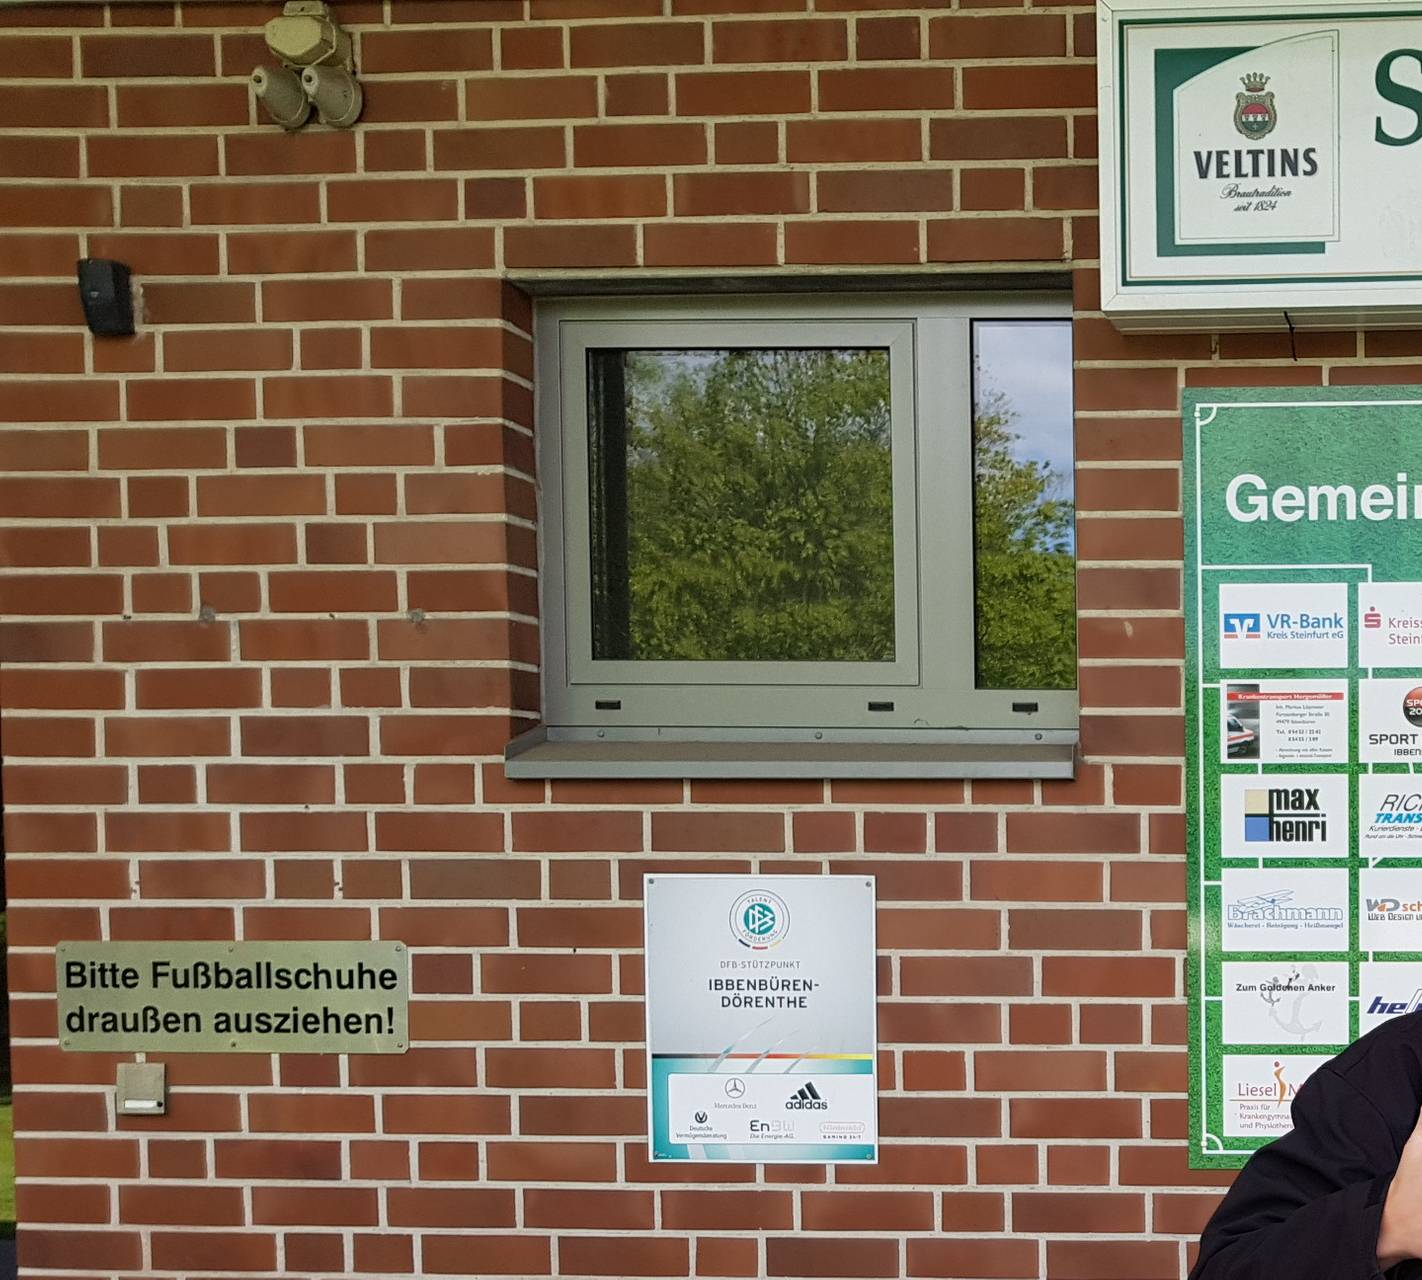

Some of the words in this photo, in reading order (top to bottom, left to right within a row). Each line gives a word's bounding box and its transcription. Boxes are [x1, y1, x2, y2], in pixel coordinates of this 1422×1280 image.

[1193, 147, 1318, 179] VELTINS
[1220, 183, 1292, 199] Brautradition
[1233, 202, 1251, 212] seit
[1253, 200, 1278, 212] 1824
[1266, 613, 1344, 629] VR-Bank
[1267, 631, 1288, 639] Kreis
[1290, 630, 1328, 640] Steinfurt
[1330, 631, 1344, 640] eG
[1369, 733, 1418, 745] SPORT
[1269, 788, 1319, 810] max
[1269, 814, 1327, 842] henri
[1228, 904, 1344, 920] Brachmann
[65, 961, 140, 989] Bitte
[152, 961, 398, 990] Fußballschuhe
[708, 976, 820, 992] IBBENBÜREN-
[1236, 983, 1257, 992] Zum
[1259, 983, 1304, 992] Goldenen
[1308, 983, 1336, 992] Anker
[721, 993, 808, 1008] DÖRENTHE
[66, 1005, 202, 1034] draußen
[214, 1006, 395, 1035] ausziehen!
[1238, 1083, 1277, 1097] Liesel
[785, 1098, 828, 1110] adidas
[1239, 1112, 1291, 1121] Krankengymna
